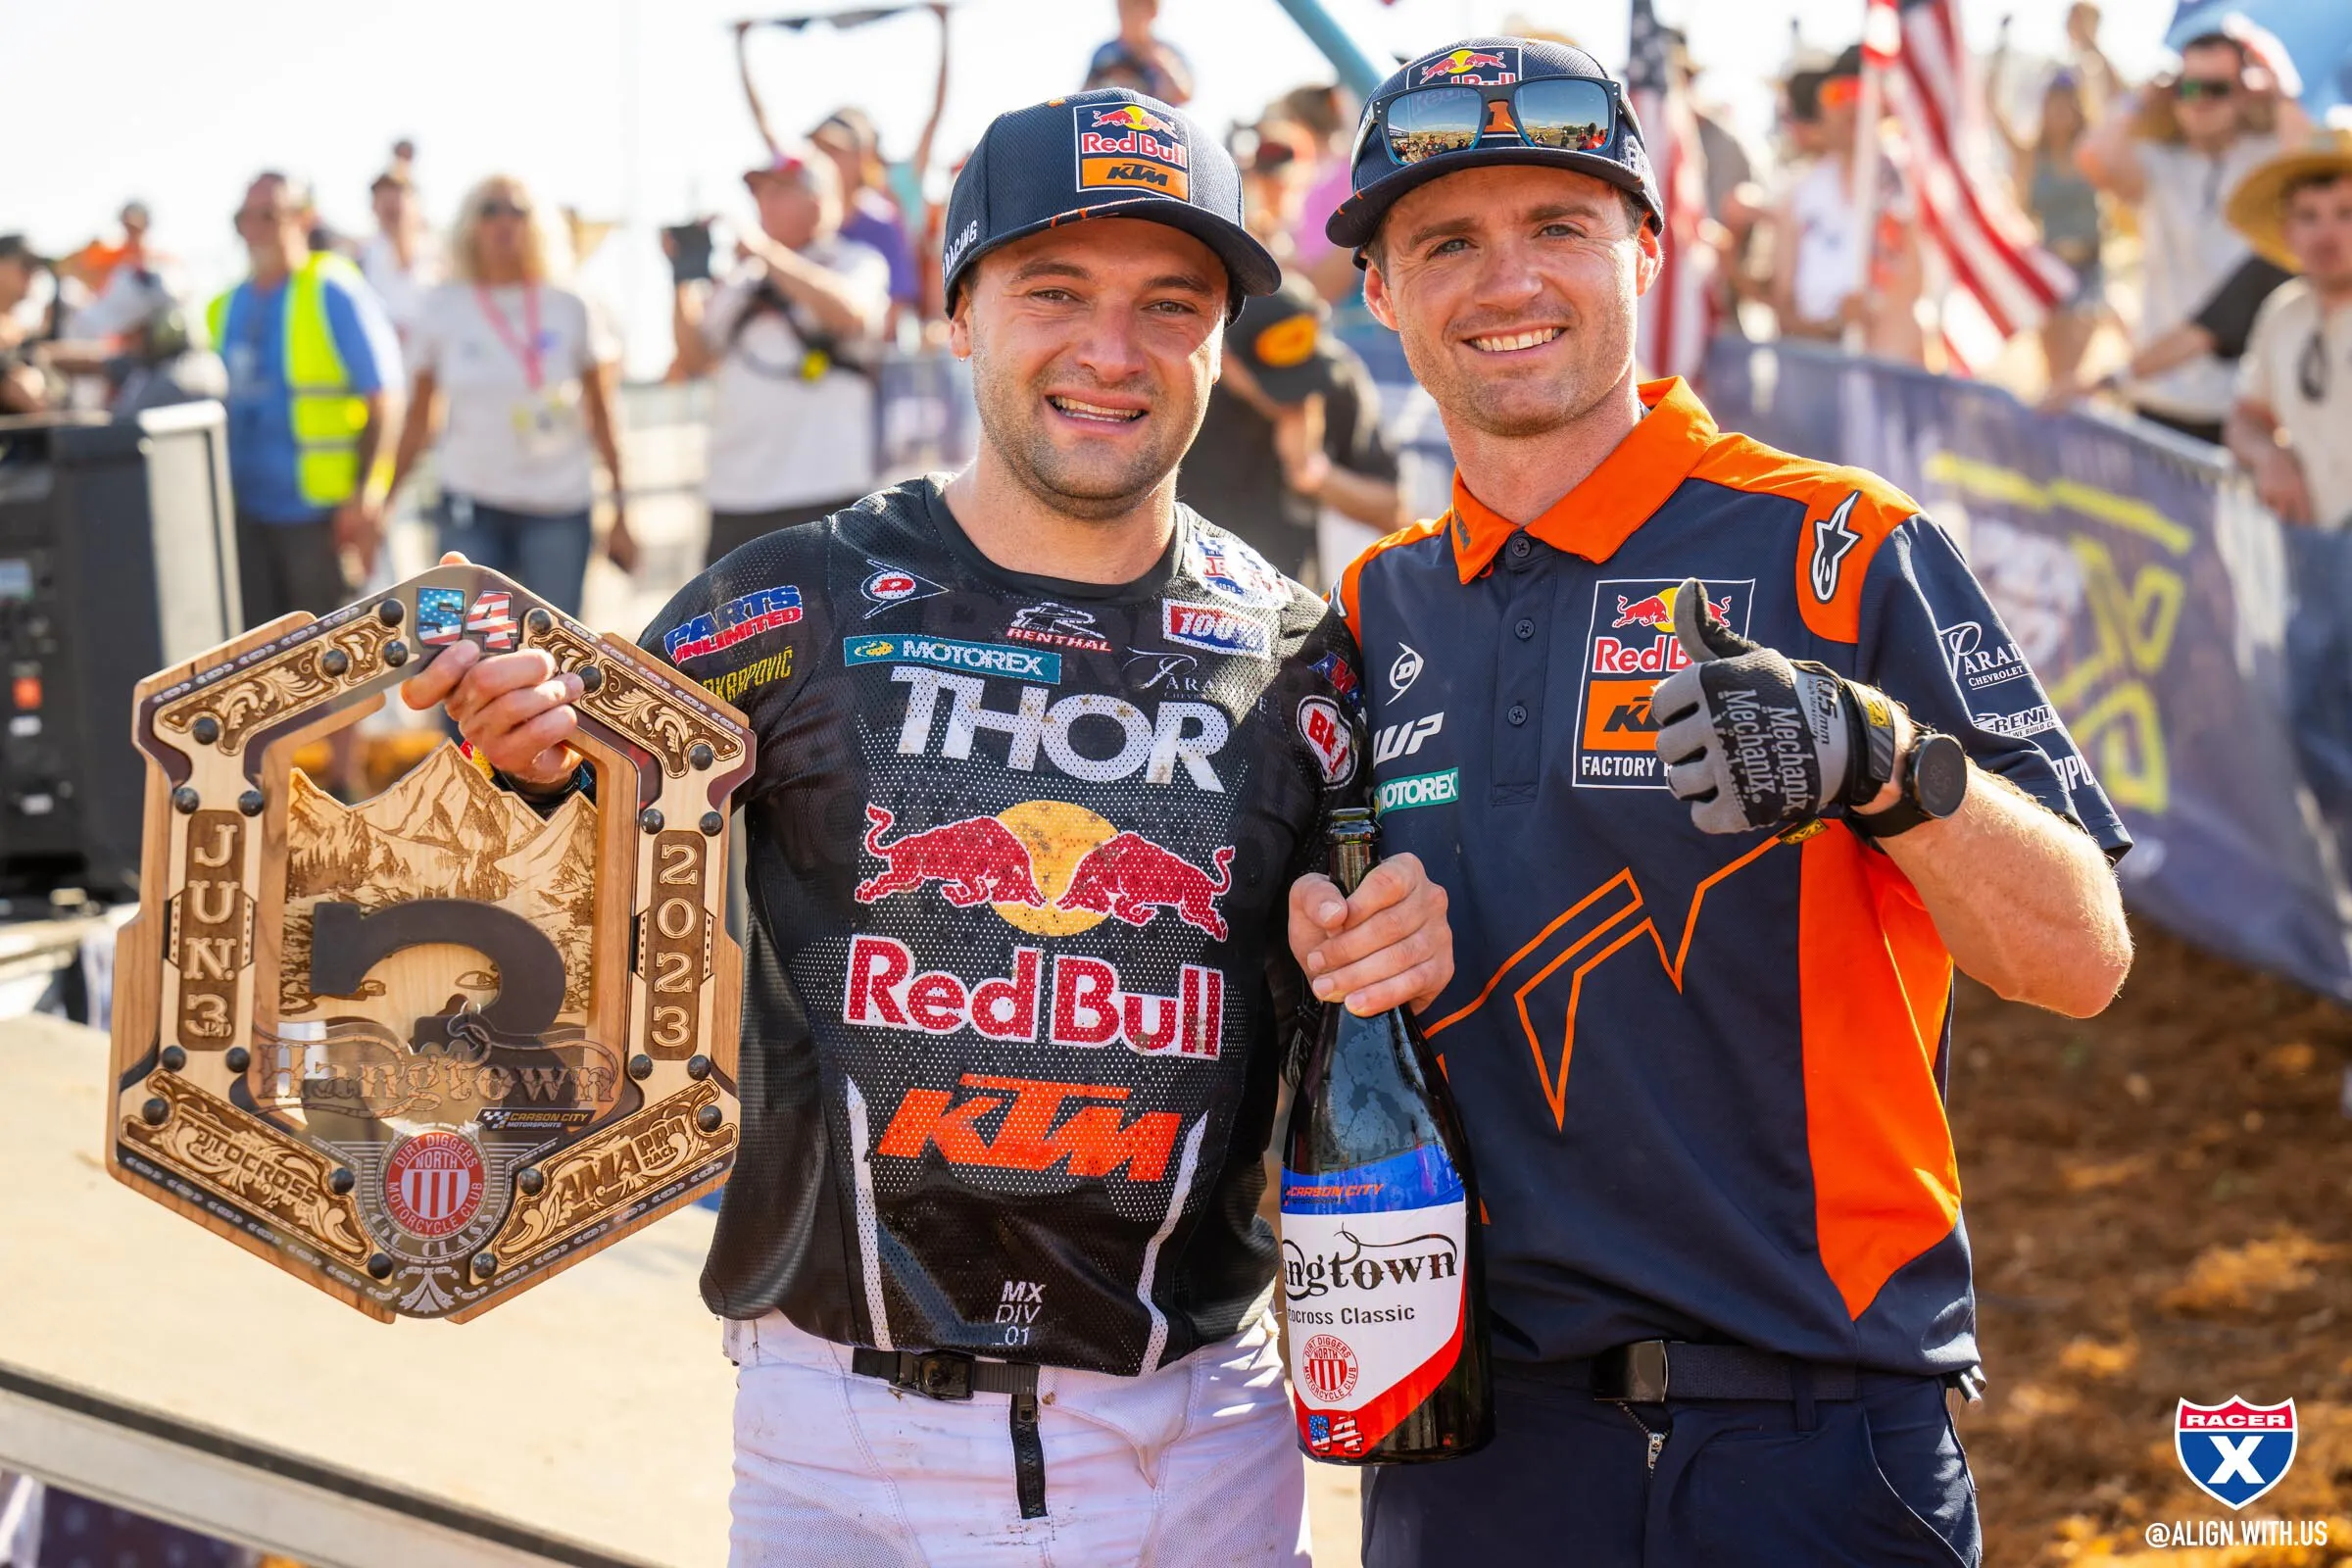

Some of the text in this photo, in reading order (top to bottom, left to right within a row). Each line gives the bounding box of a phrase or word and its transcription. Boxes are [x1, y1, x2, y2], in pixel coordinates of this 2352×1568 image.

[1081, 130, 1187, 169] Red Bull
[1106, 164, 1168, 186] KTM
[946, 220, 977, 278] RACING
[663, 585, 803, 658] PARTS
[671, 607, 804, 666] UNLIMITED
[1005, 627, 1112, 653] RENTHAL
[1592, 635, 1667, 673] Red
[903, 640, 1044, 676] MOTOREX
[1969, 665, 2024, 687] CHEVROLET
[891, 665, 1226, 793] THOR
[1582, 756, 1656, 777] FACTORY
[844, 934, 1224, 1060] Red Bull
[257, 1041, 615, 1111] Hangtown
[510, 1112, 589, 1122] CARSON CITY
[877, 1073, 1182, 1182] KTM
[395, 1134, 479, 1168] DIRT DIGGERS
[416, 1151, 459, 1169] NORTH
[1290, 1183, 1384, 1197] CARSON CITY
[388, 1181, 483, 1234] MOTORCYCLE CLUB
[1001, 1280, 1047, 1303] MX
[995, 1303, 1042, 1323] DIV
[1341, 1304, 1416, 1324] Classic
[1304, 1337, 1351, 1358] DIRT DIGGERS
[1314, 1348, 1339, 1359] NORTH
[1303, 1366, 1356, 1400] MOTORCYCLE CLUB
